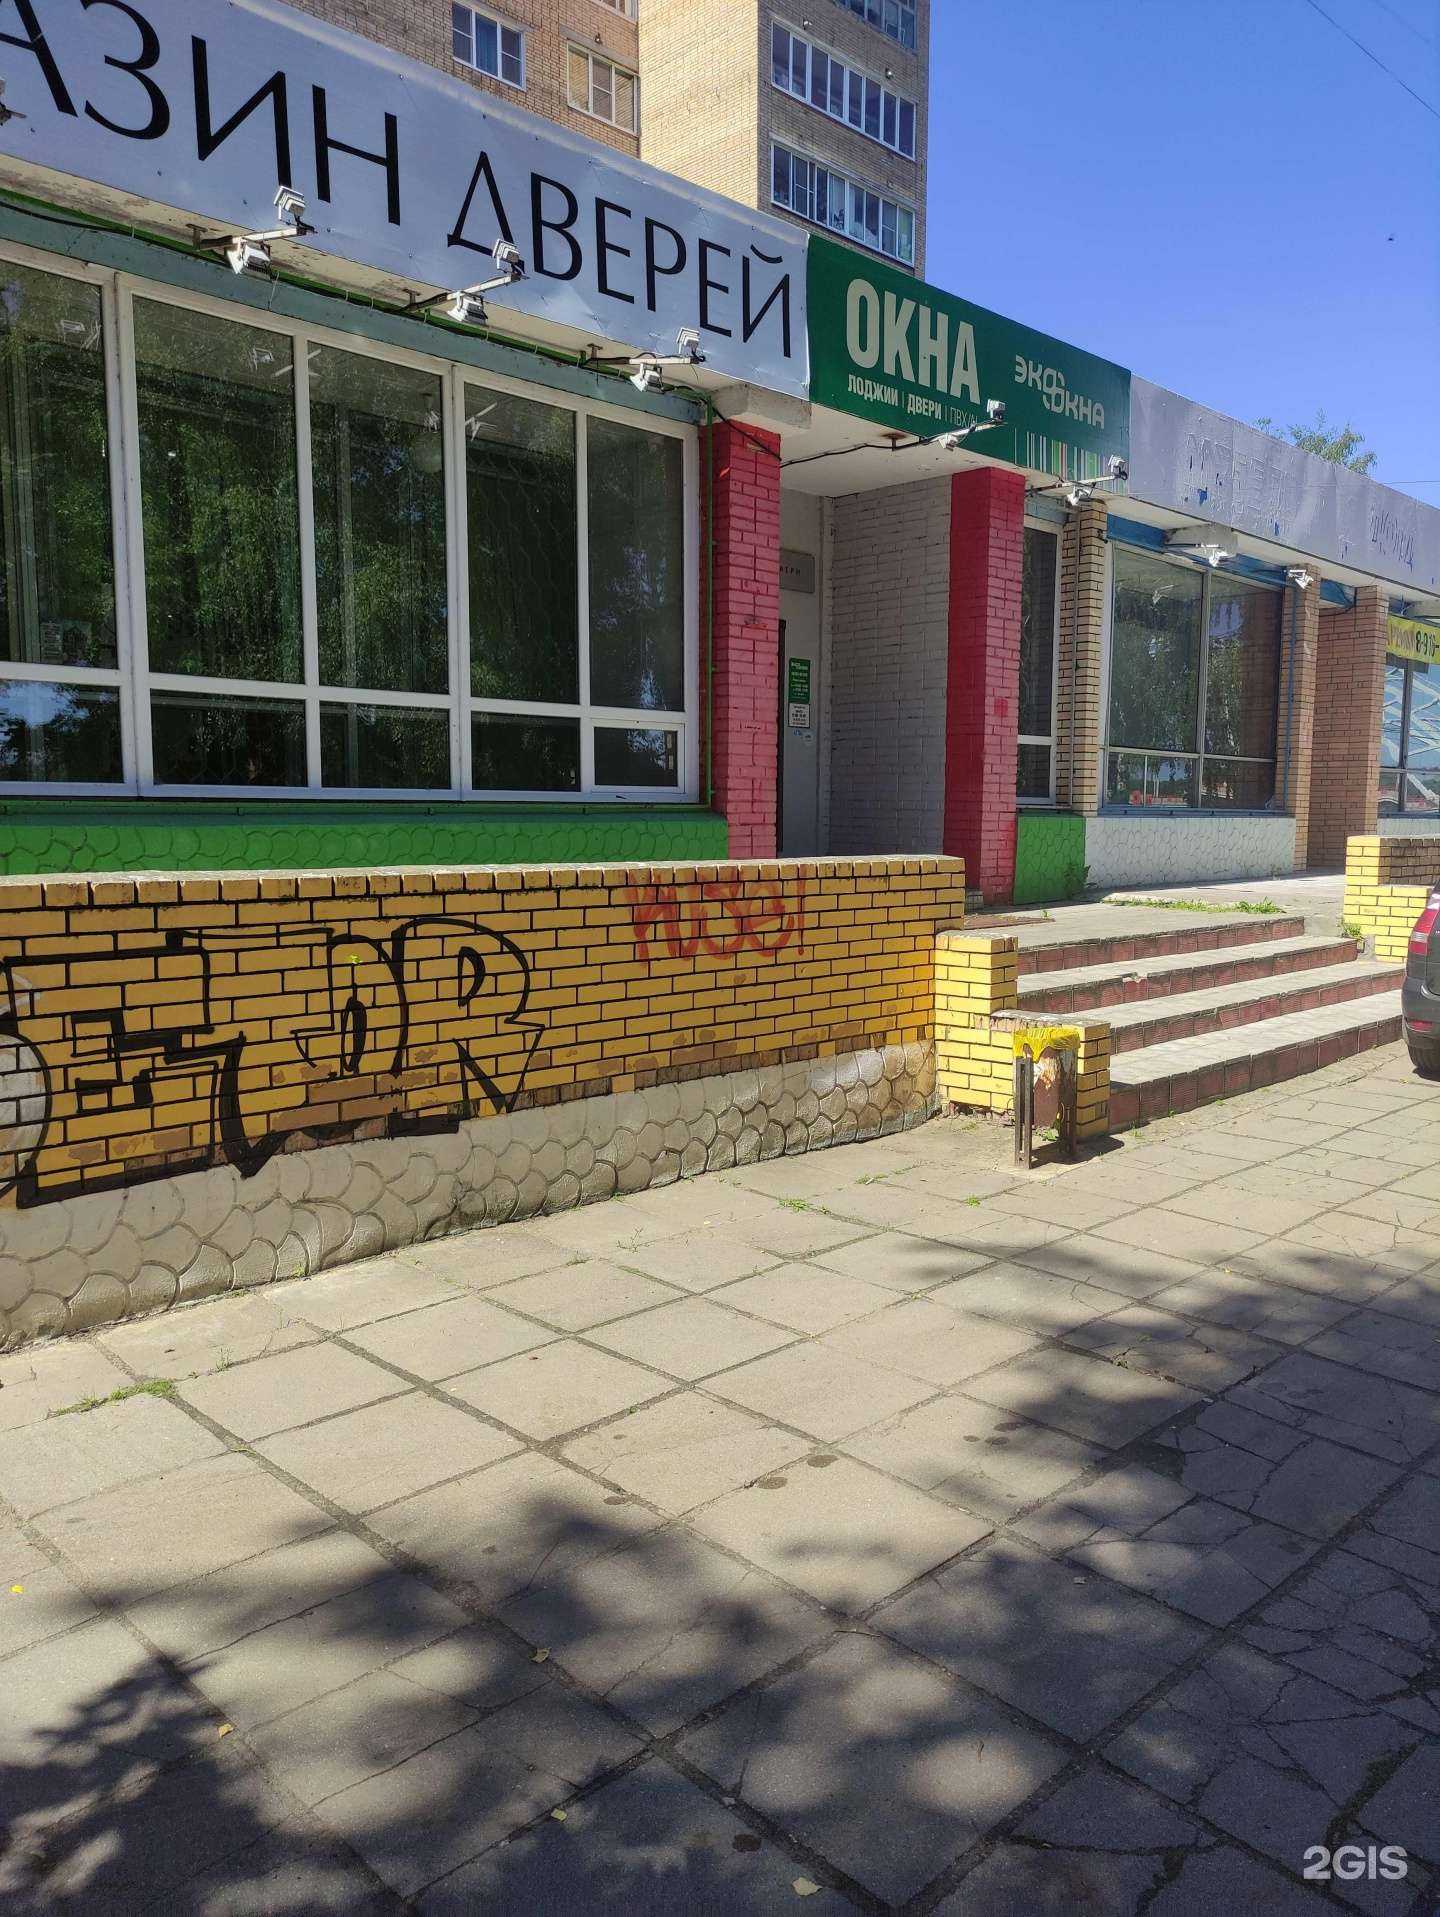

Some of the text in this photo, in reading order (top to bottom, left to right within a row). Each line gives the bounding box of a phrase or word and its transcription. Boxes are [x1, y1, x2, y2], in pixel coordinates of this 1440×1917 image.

[447, 150, 792, 358] ДВЕРЕЙ
[846, 278, 981, 405] ОКНА
[848, 374, 899, 407] ЛОДЖИИ
[907, 394, 942, 420] ДВЕРИ
